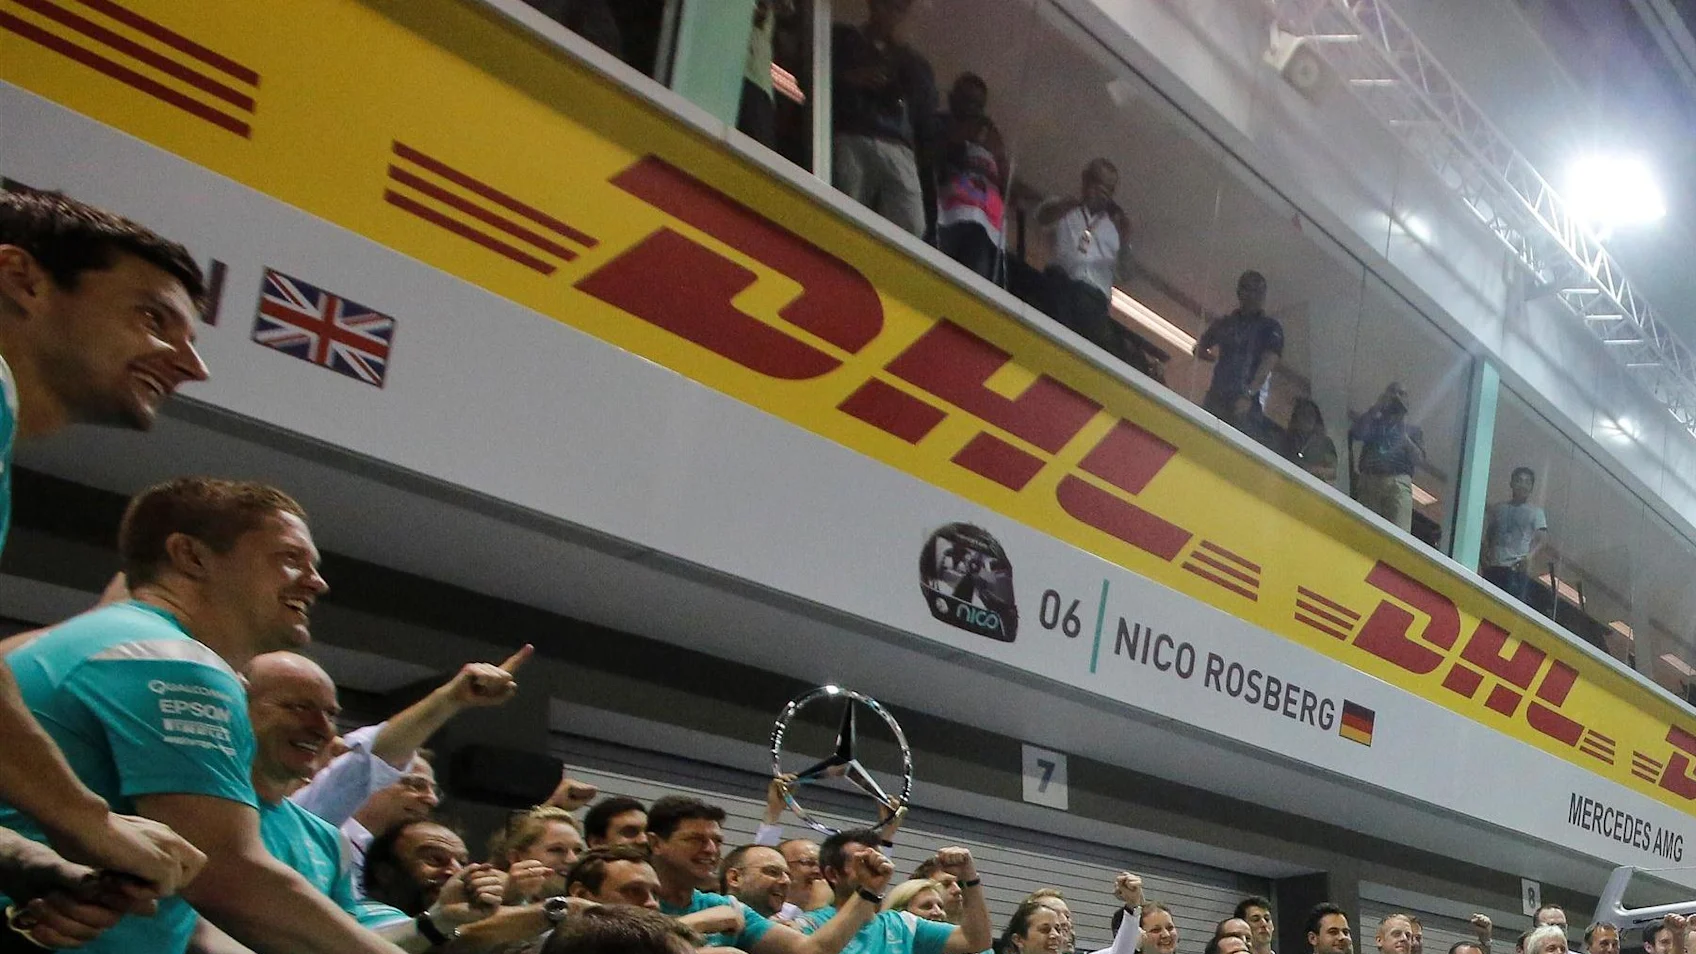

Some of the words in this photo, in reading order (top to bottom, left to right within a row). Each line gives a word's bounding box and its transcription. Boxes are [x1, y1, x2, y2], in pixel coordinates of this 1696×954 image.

[573, 153, 1194, 562] DHL
[1039, 588, 1081, 639] 06
[1114, 616, 1196, 679] NICO
[1203, 652, 1336, 731] ROSBERG
[1351, 559, 1586, 748] DHL
[1037, 758, 1056, 794] 7
[1568, 792, 1652, 852] MERCEDES
[1652, 827, 1684, 862] AMG
[1527, 887, 1537, 909] 8
